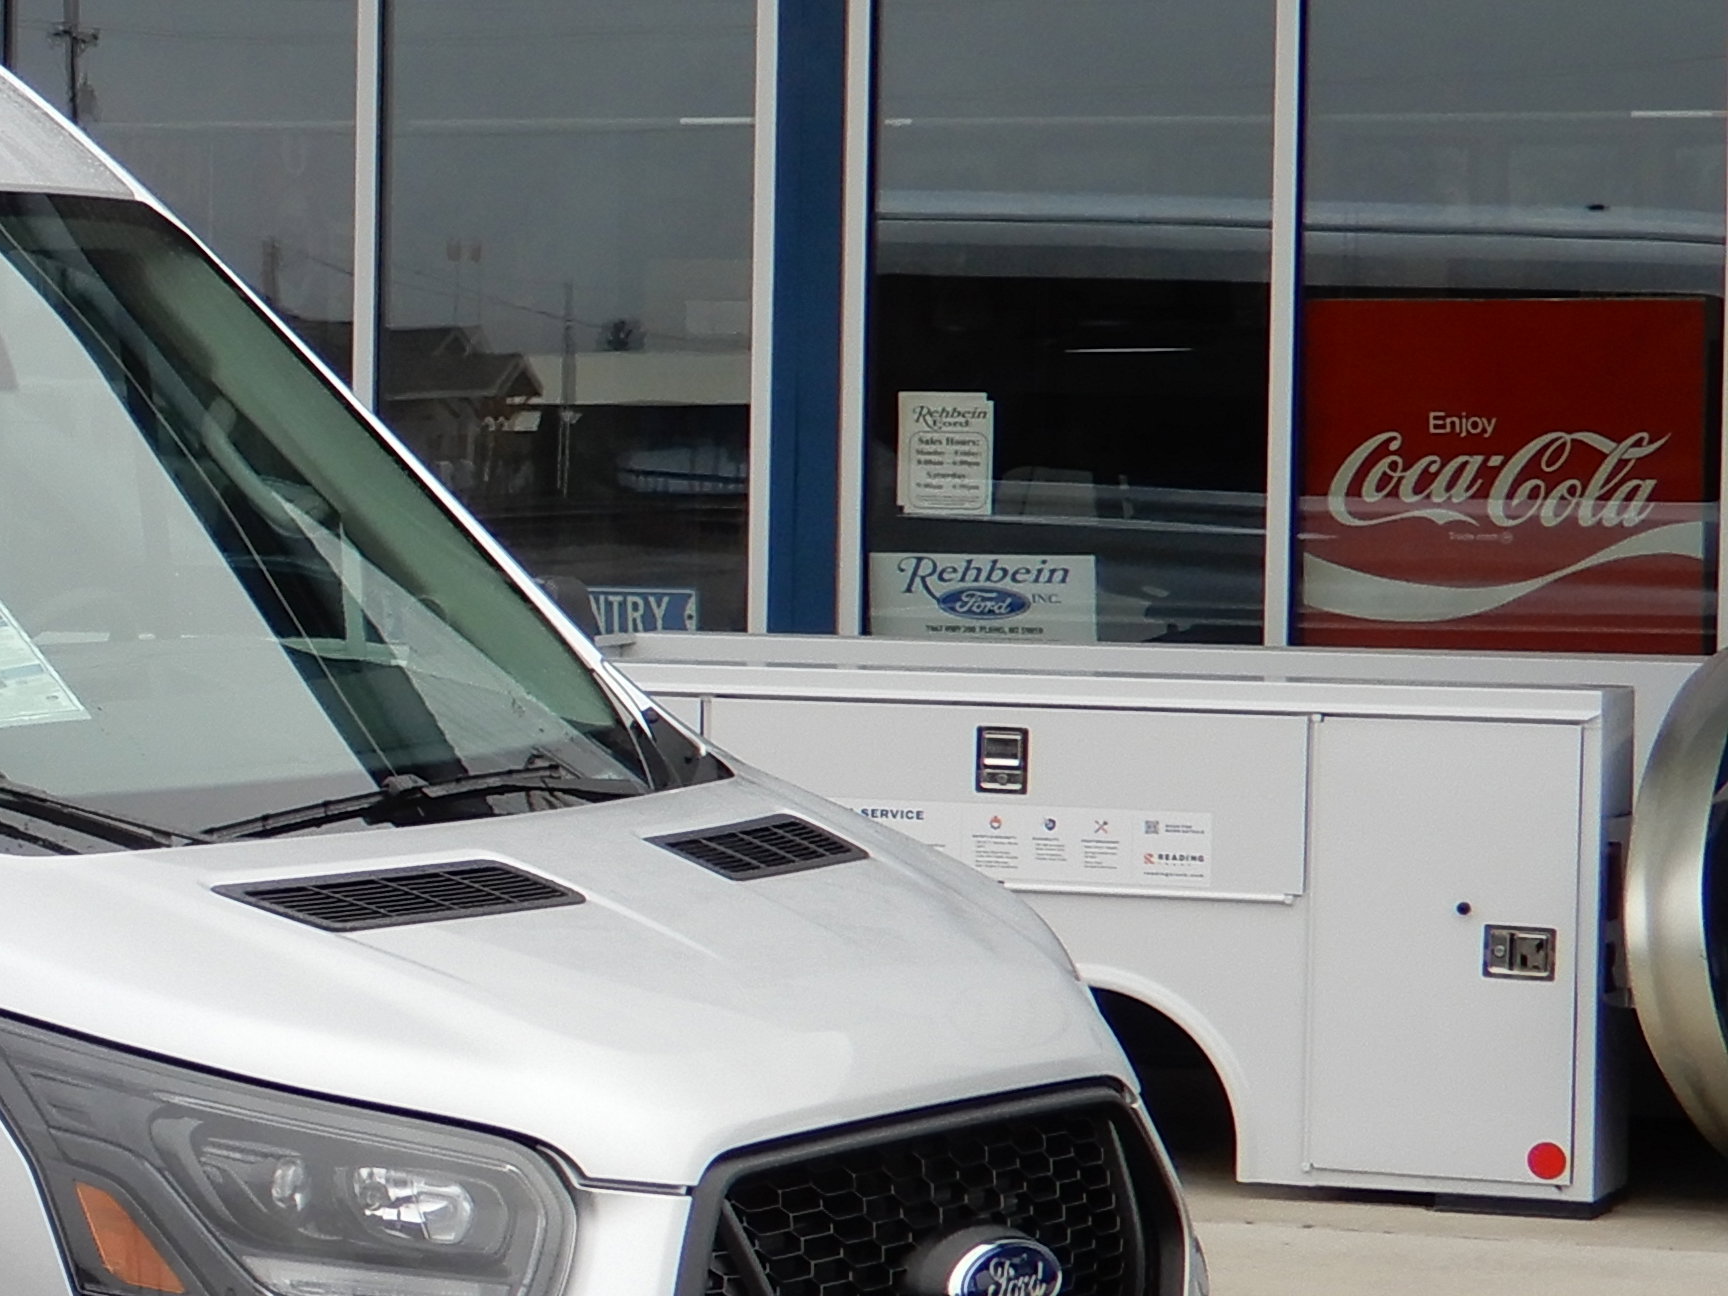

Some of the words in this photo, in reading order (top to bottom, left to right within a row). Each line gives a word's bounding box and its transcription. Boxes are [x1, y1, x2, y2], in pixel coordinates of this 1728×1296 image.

[913, 405, 988, 430] Rehbein
[1428, 411, 1497, 438] Enjoy
[918, 436, 943, 446] Sales
[1327, 430, 1672, 527] Coca-Cola
[897, 556, 1070, 600] Rehbein
[955, 590, 1012, 615] Ford
[1031, 593, 1062, 605] INC.
[588, 593, 670, 634] NTRY
[860, 808, 925, 820] SERVICE
[1157, 853, 1205, 863] READING
